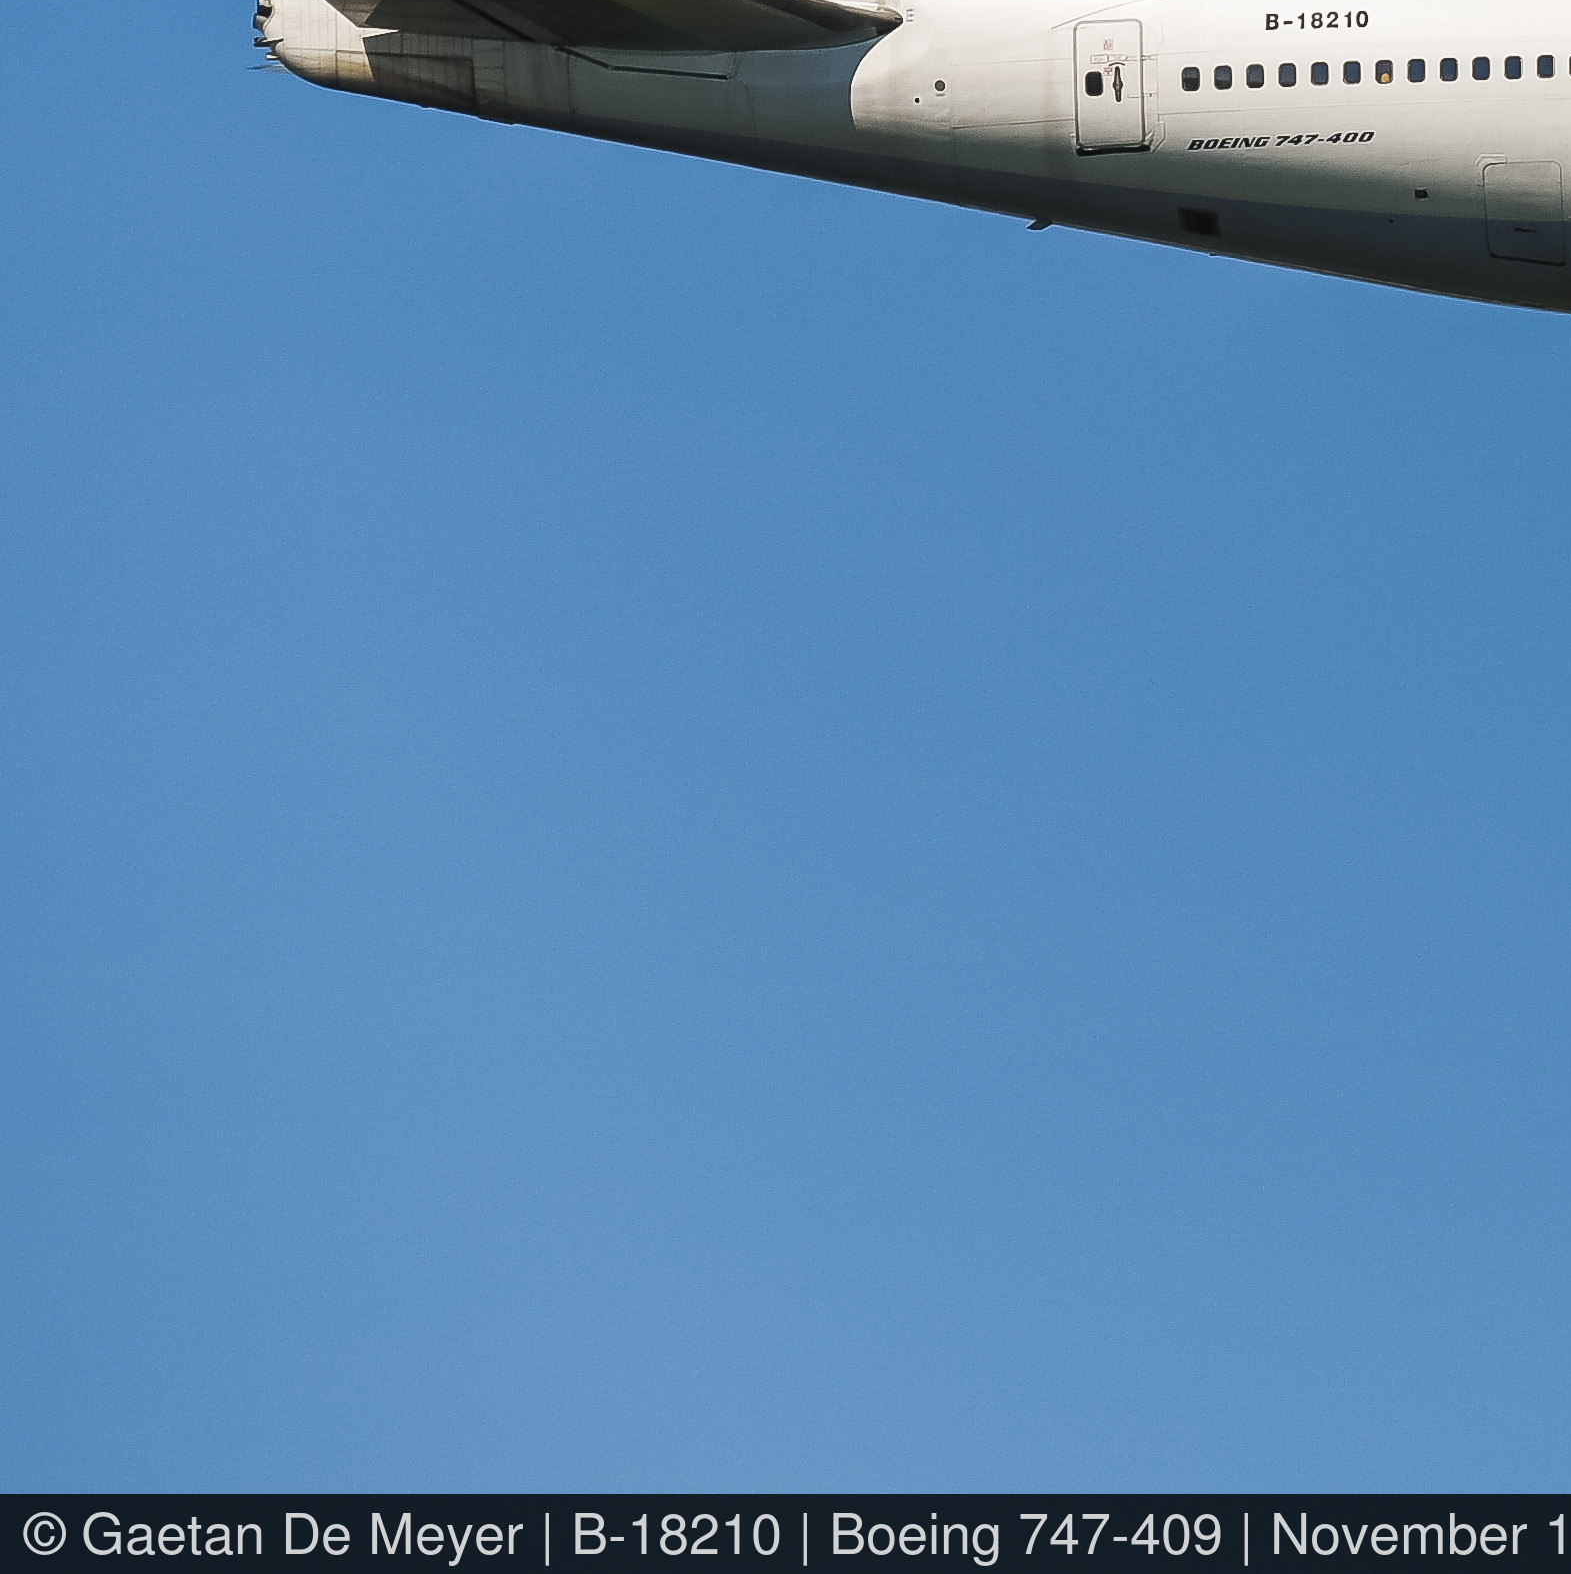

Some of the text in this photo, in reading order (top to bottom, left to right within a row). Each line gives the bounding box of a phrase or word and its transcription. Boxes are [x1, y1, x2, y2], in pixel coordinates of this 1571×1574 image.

[1265, 10, 1370, 31] B-18210
[1187, 131, 1376, 152] BOEING 747-400
